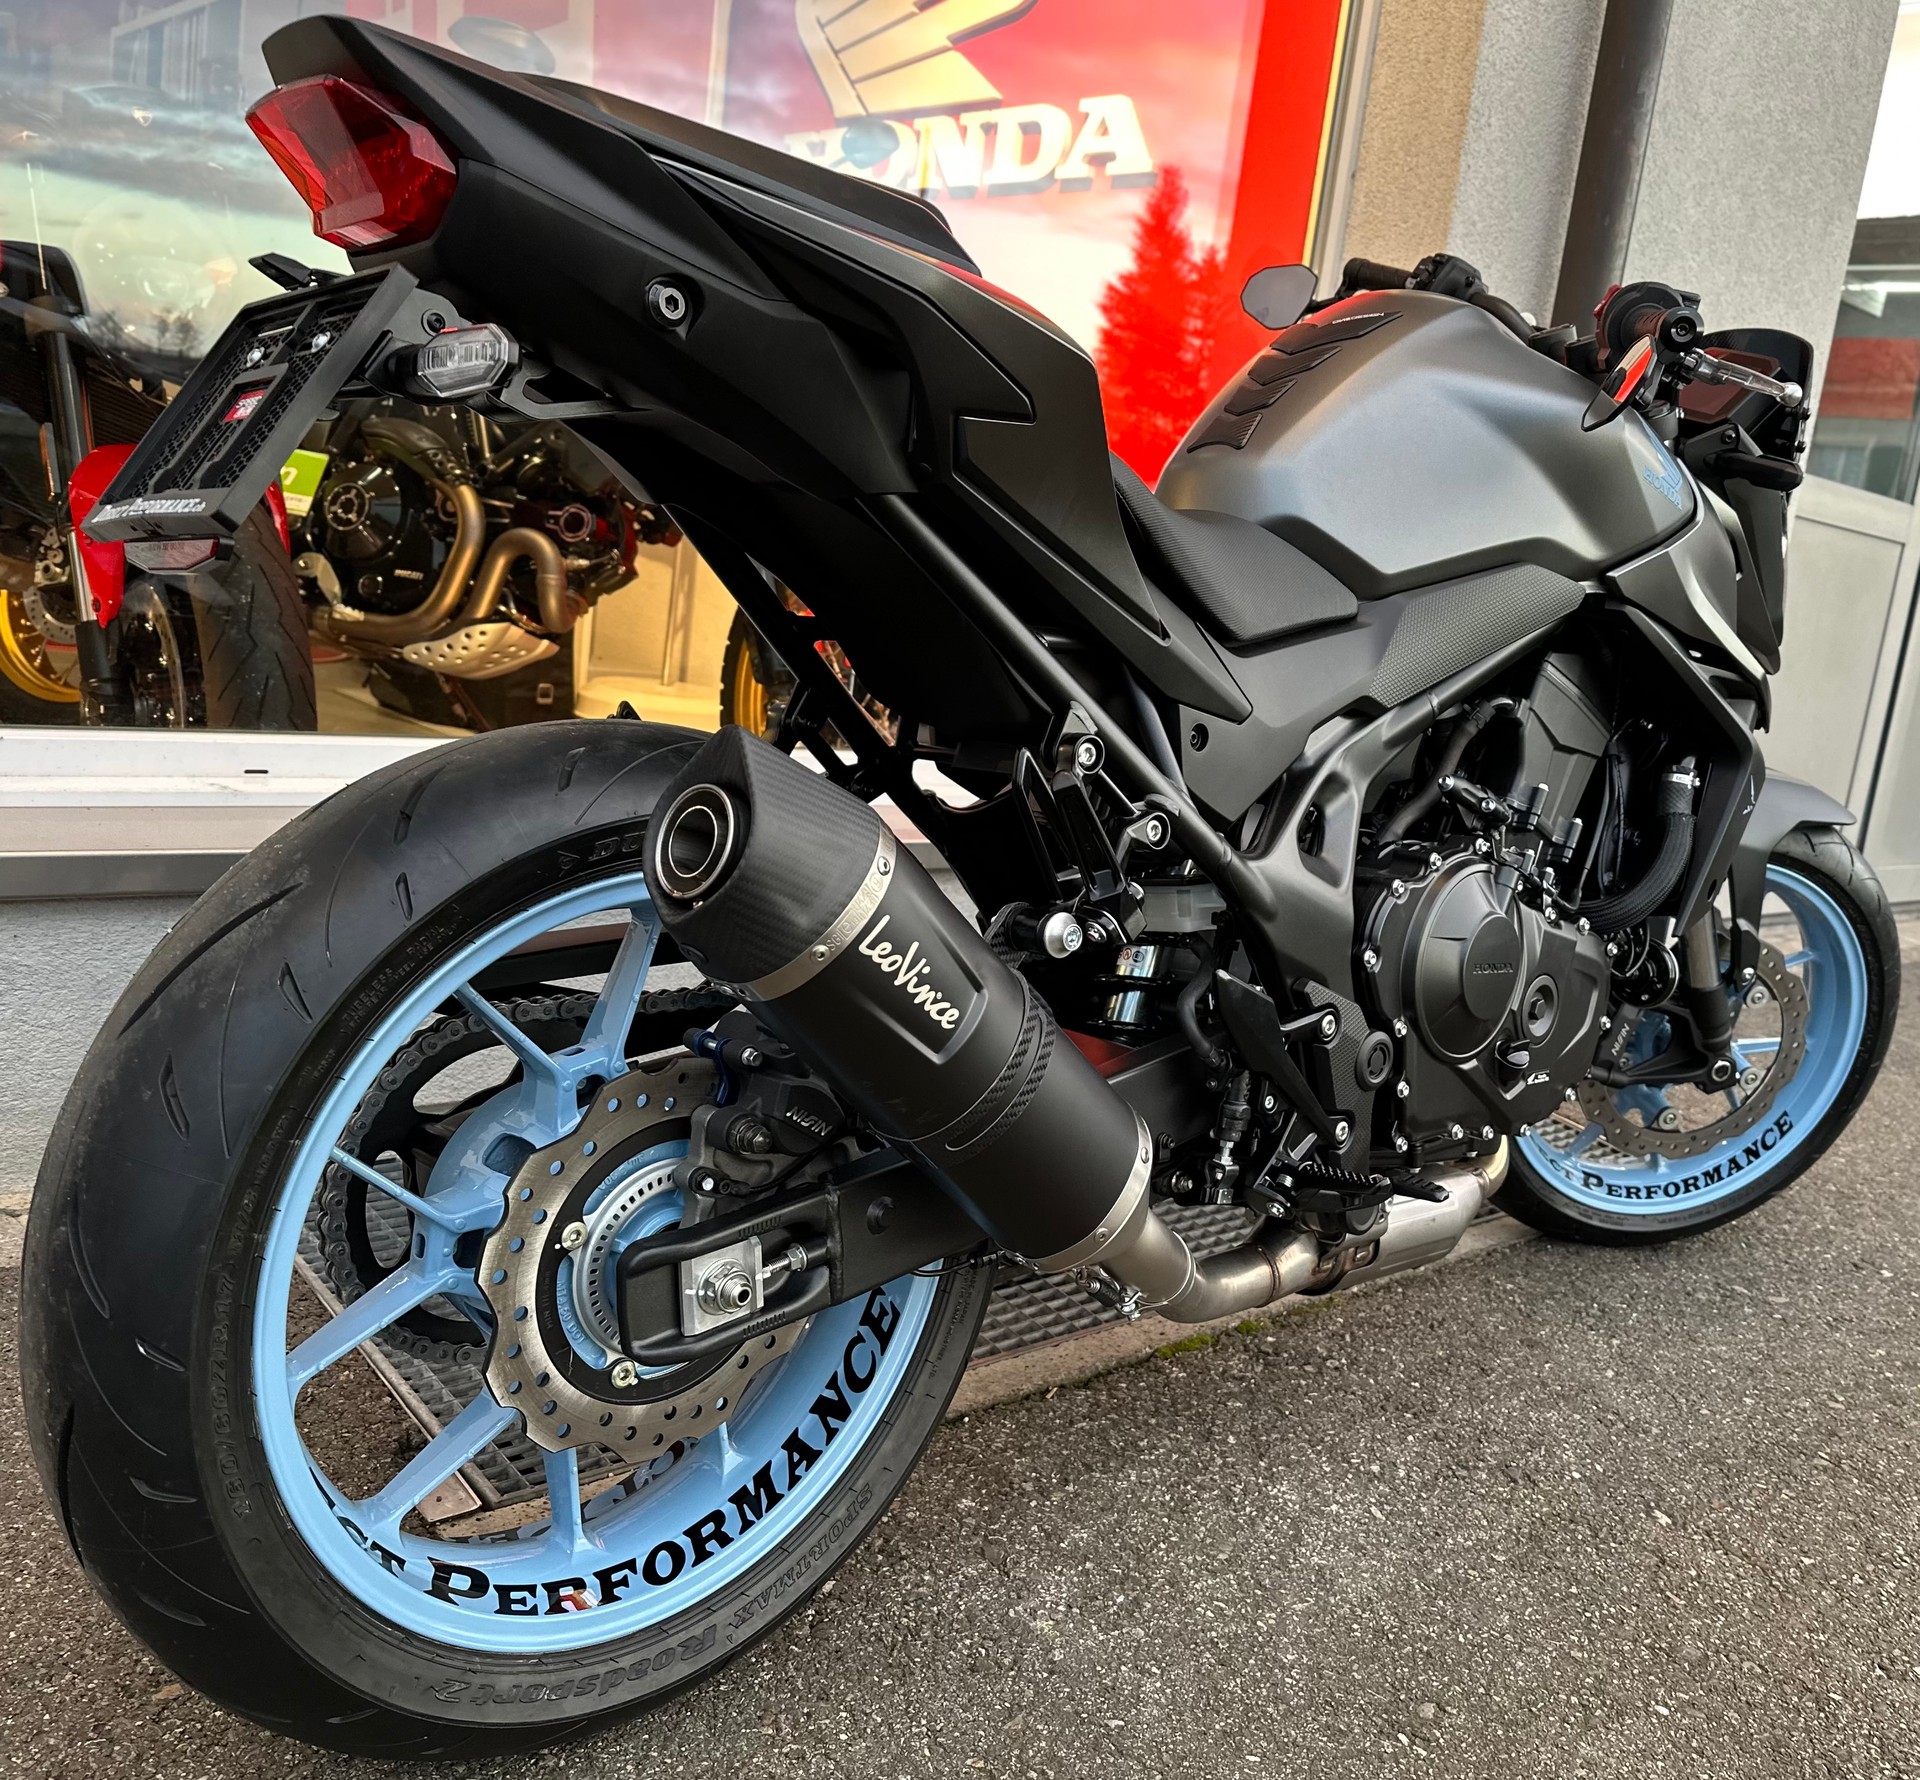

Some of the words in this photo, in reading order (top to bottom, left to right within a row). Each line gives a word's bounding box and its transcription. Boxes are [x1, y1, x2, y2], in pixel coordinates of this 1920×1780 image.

[1643, 465, 1683, 511] HONDA
[858, 914, 960, 1029] LeoVince
[1472, 962, 1514, 975] HONDA
[1580, 1110, 1795, 1200] PERFORMANCE
[424, 1286, 902, 1617] PERFORMANCE
[728, 1482, 872, 1630] SPORTMAX
